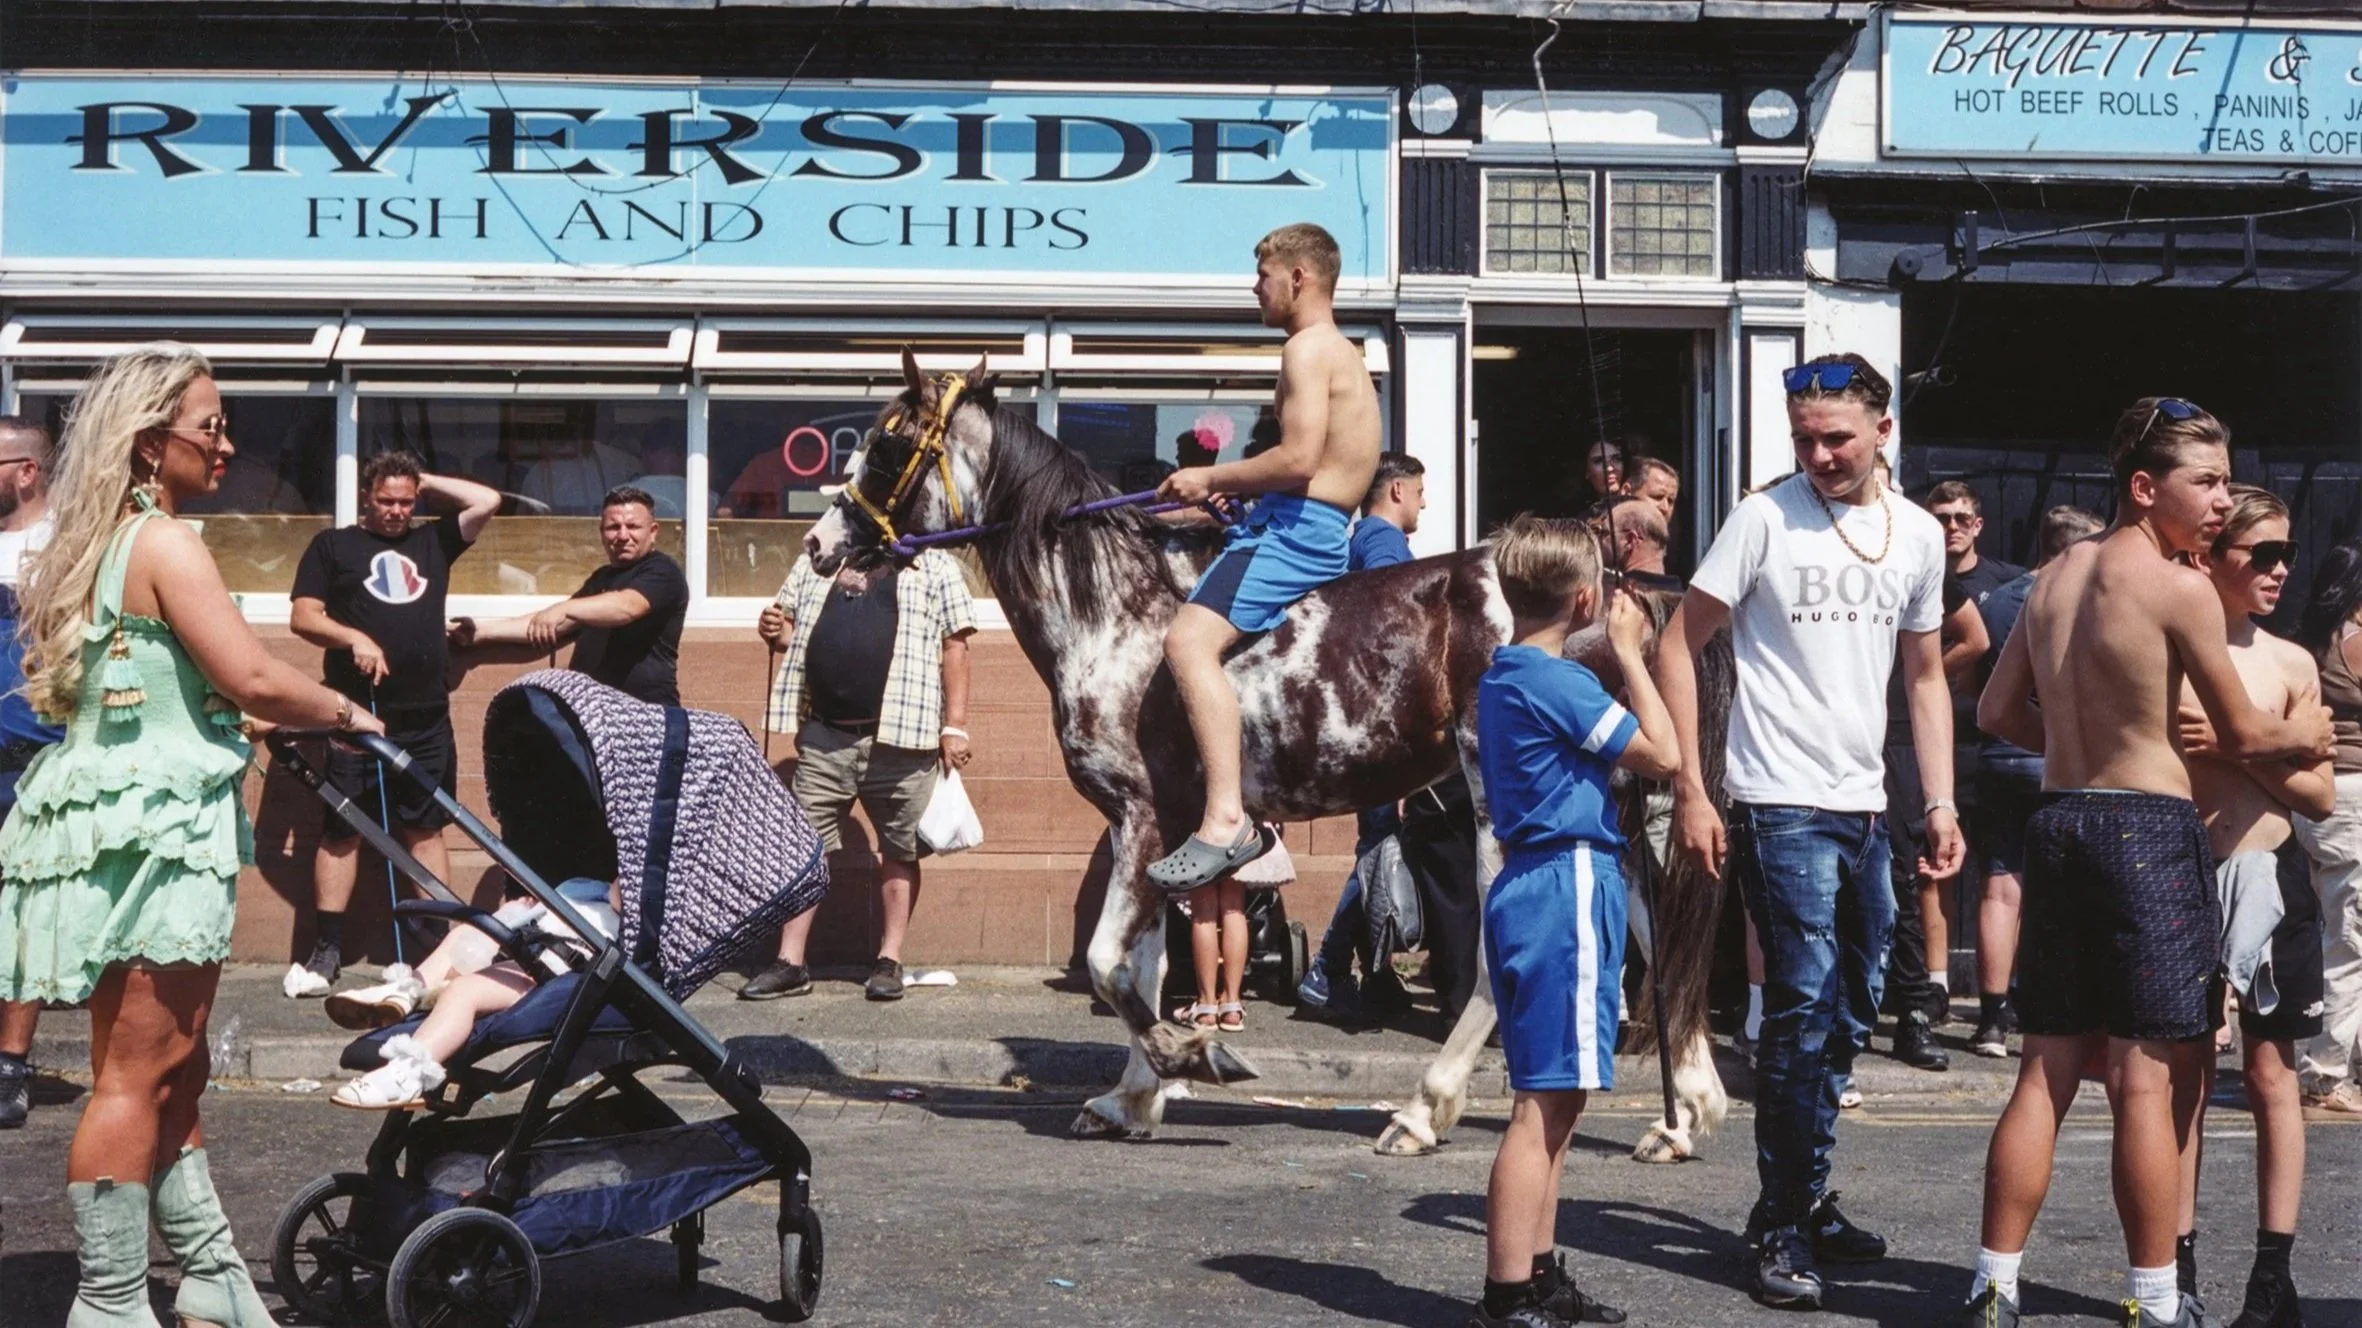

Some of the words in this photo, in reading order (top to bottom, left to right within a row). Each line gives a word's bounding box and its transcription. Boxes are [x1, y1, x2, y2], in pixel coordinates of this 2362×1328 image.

[1931, 25, 2214, 88] BAGUETTE
[2269, 36, 2312, 83] &
[1954, 90, 2006, 113] HOT
[2020, 91, 2084, 116] BEEF
[2100, 92, 2179, 117] ROLLS
[2214, 94, 2310, 120] PANINIS
[62, 88, 1322, 187] RIVERSIDE
[2203, 127, 2265, 152] TEAS
[2279, 129, 2295, 153] &
[2309, 130, 2362, 155] COF
[306, 197, 488, 240] FISH
[556, 199, 764, 245] AND
[828, 204, 1090, 251] CHIPS
[784, 426, 876, 476] OP
[1792, 611, 1858, 624] HUGO
